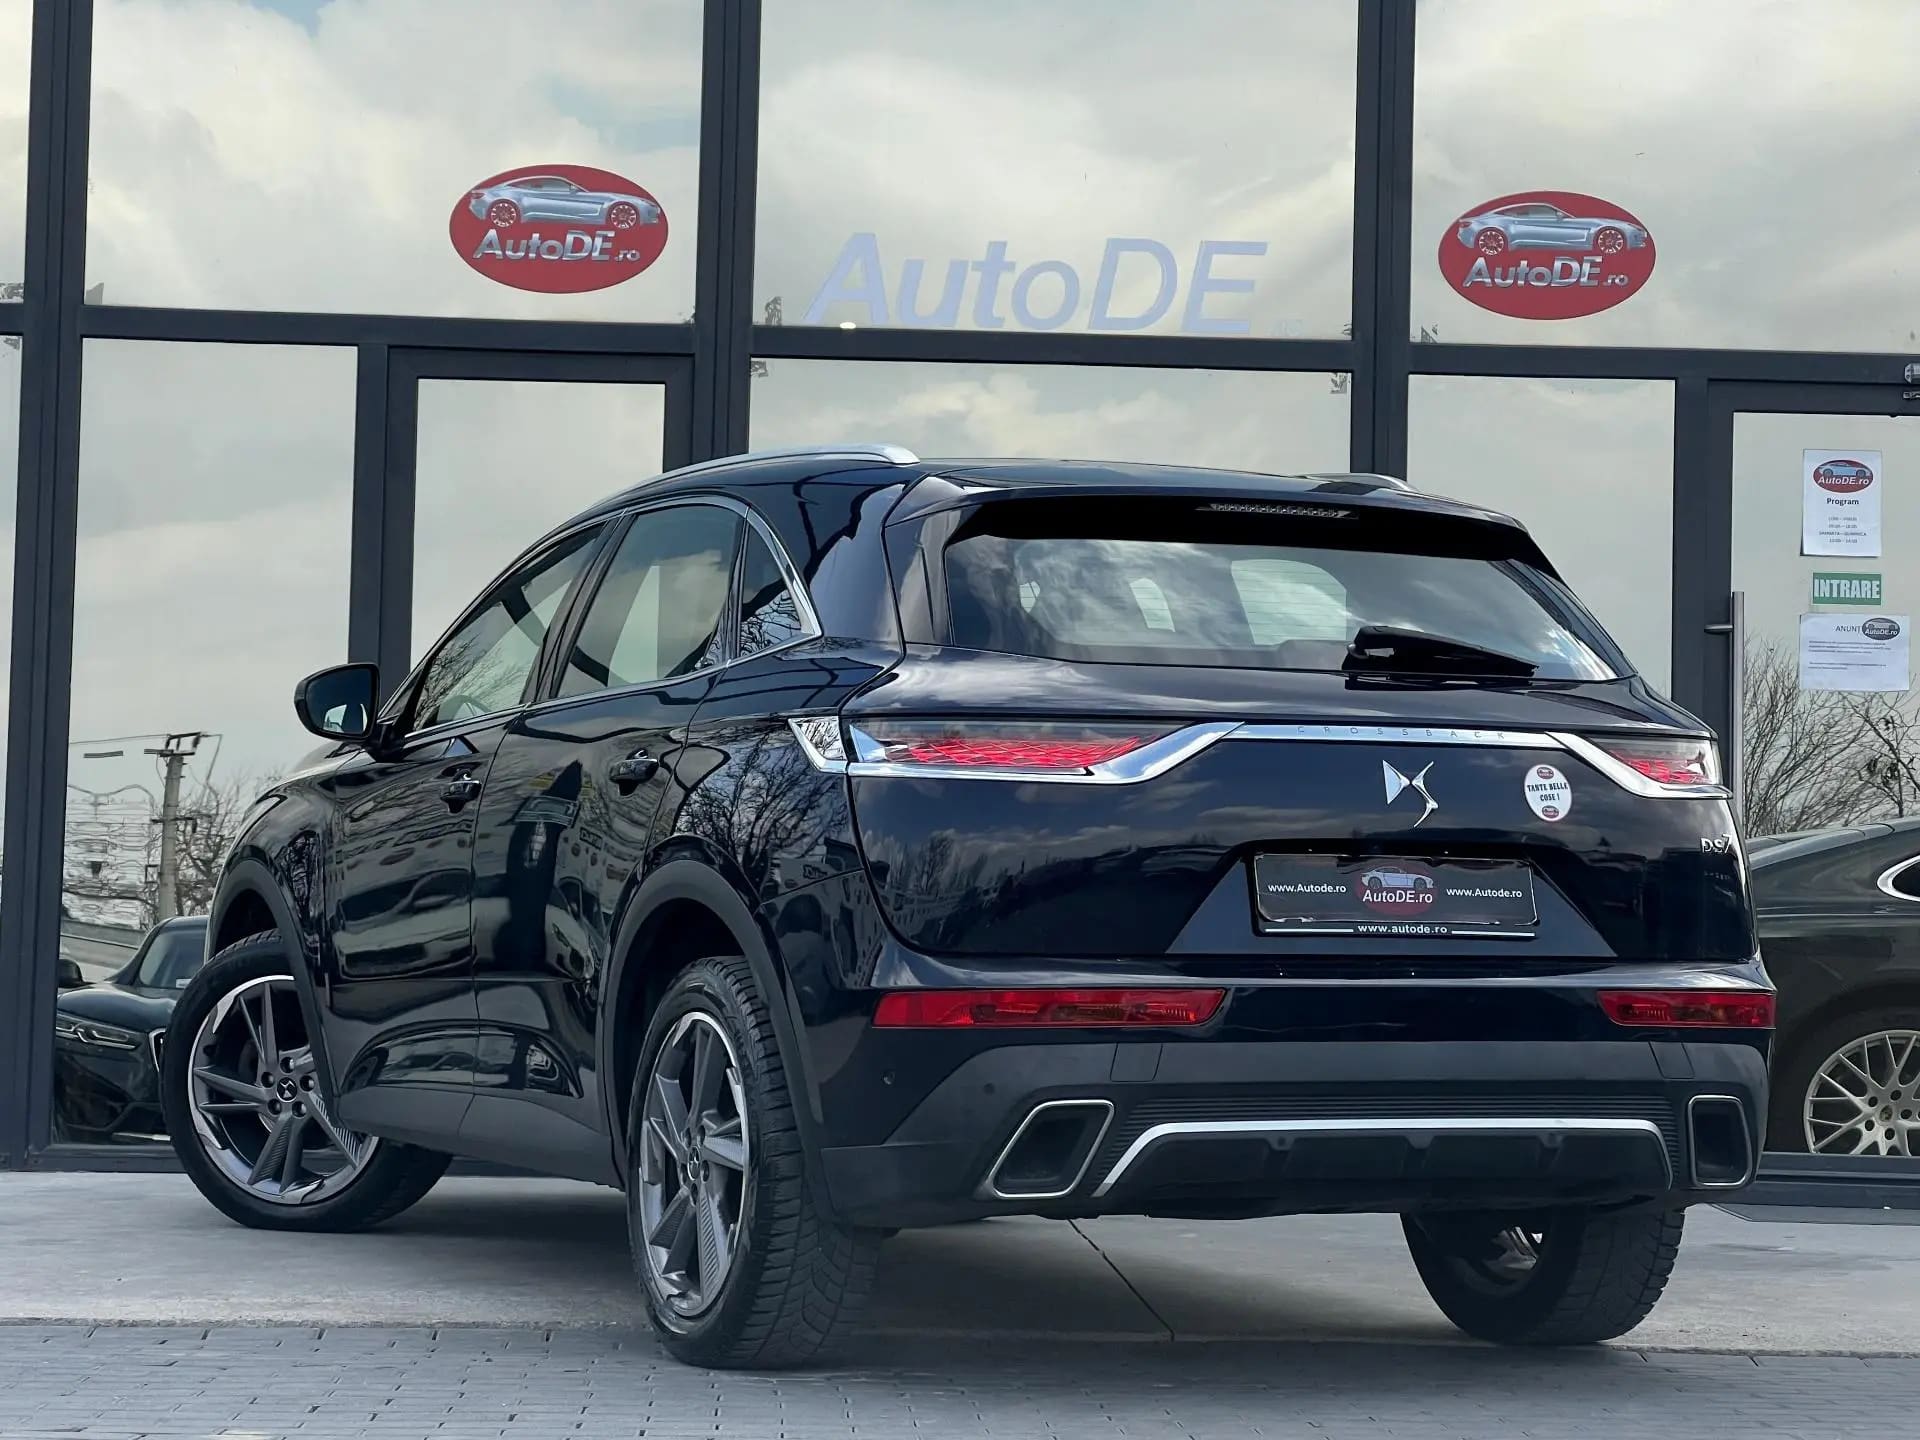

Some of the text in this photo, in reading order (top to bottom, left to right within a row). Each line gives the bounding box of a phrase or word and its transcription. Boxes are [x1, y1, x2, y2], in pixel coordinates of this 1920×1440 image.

[1818, 476, 1870, 485] AutoDE.ro
[1826, 497, 1860, 507] Program
[1814, 579, 1880, 598] INTRARE
[1297, 725, 1505, 740] CROSSBACK
[1527, 782, 1568, 792] TANTE BELLE
[1540, 793, 1556, 802] COSE
[1267, 883, 1347, 893] www.Autode.ro
[1446, 888, 1523, 898] www.Autode.ro
[1362, 889, 1433, 903] AutoDE.ro
[1357, 924, 1448, 934] www.autode.ro
